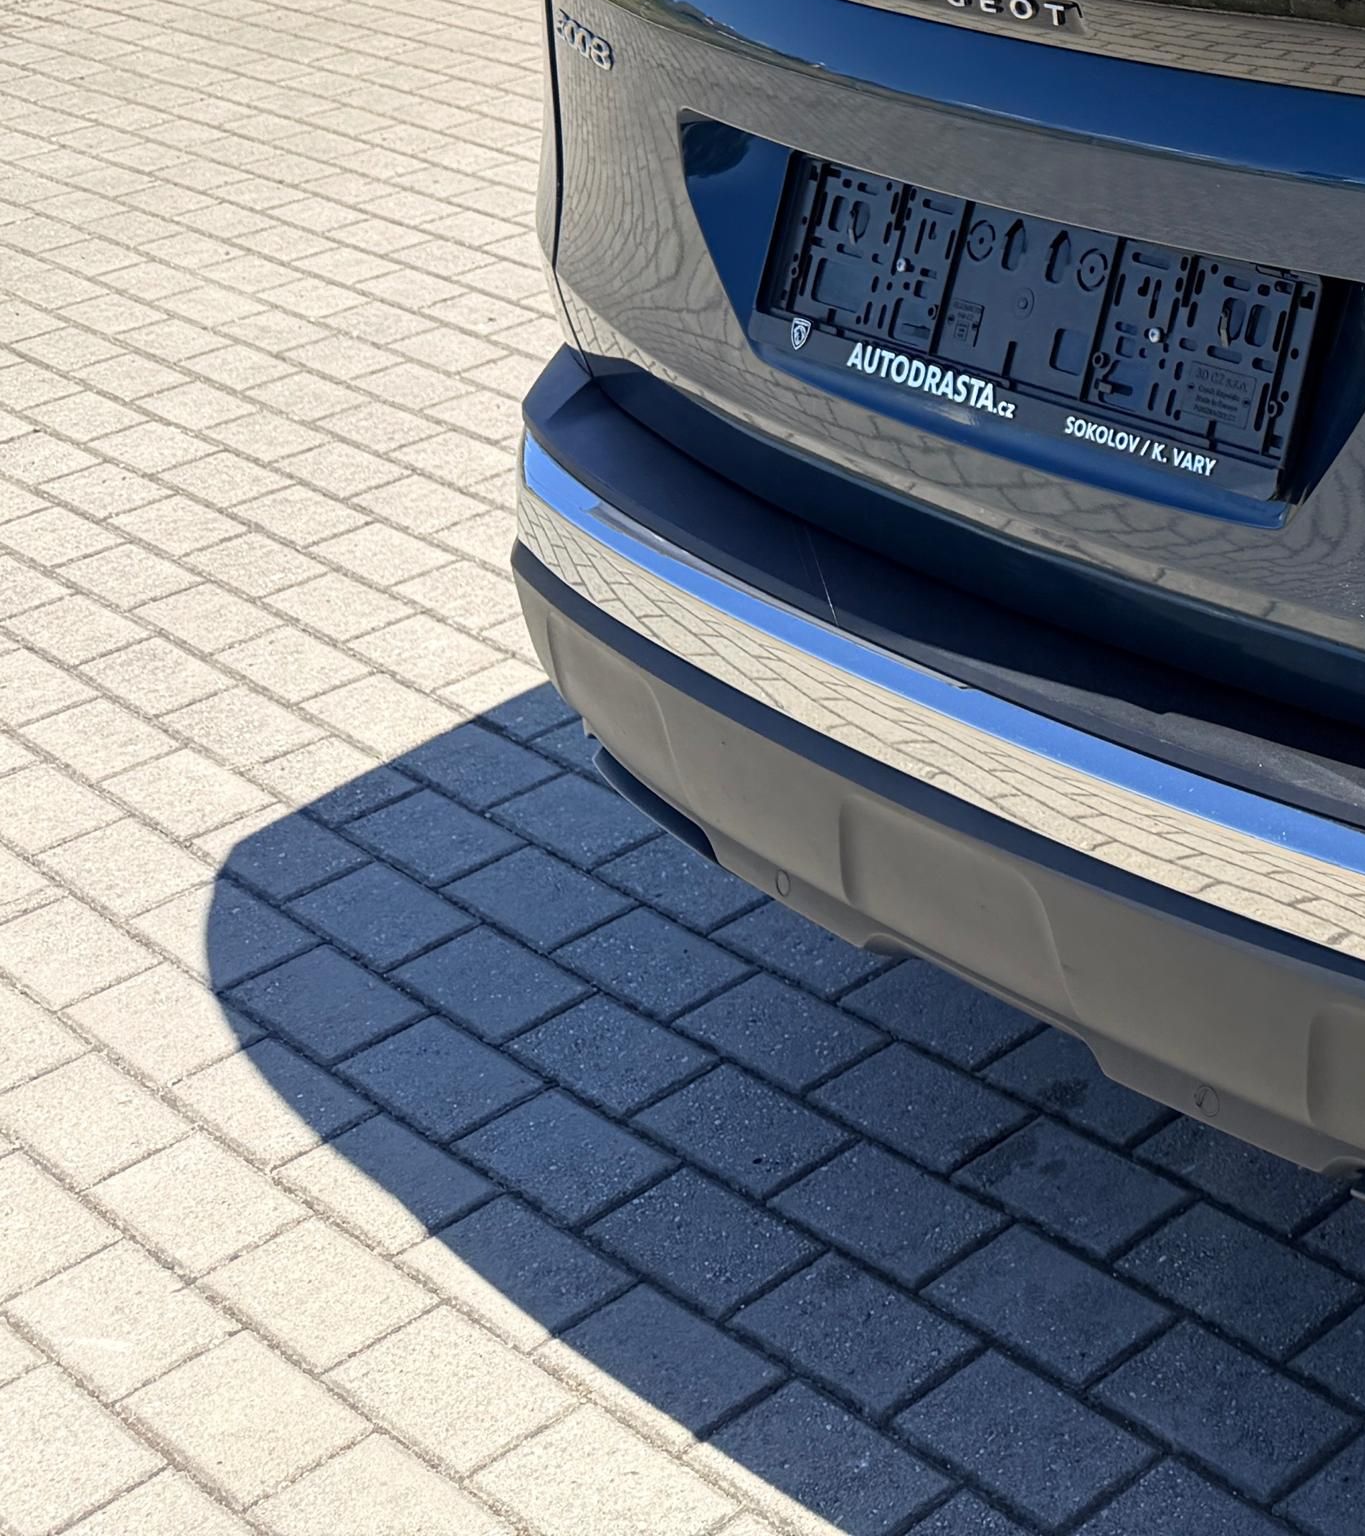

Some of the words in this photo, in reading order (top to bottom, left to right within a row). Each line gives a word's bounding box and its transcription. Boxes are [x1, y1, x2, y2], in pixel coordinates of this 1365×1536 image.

[846, 342, 1016, 419] AUTODRASTA.cz
[1065, 416, 1140, 453] SOKOLOV
[1151, 443, 1167, 463] K.
[1173, 448, 1217, 476] VARY
